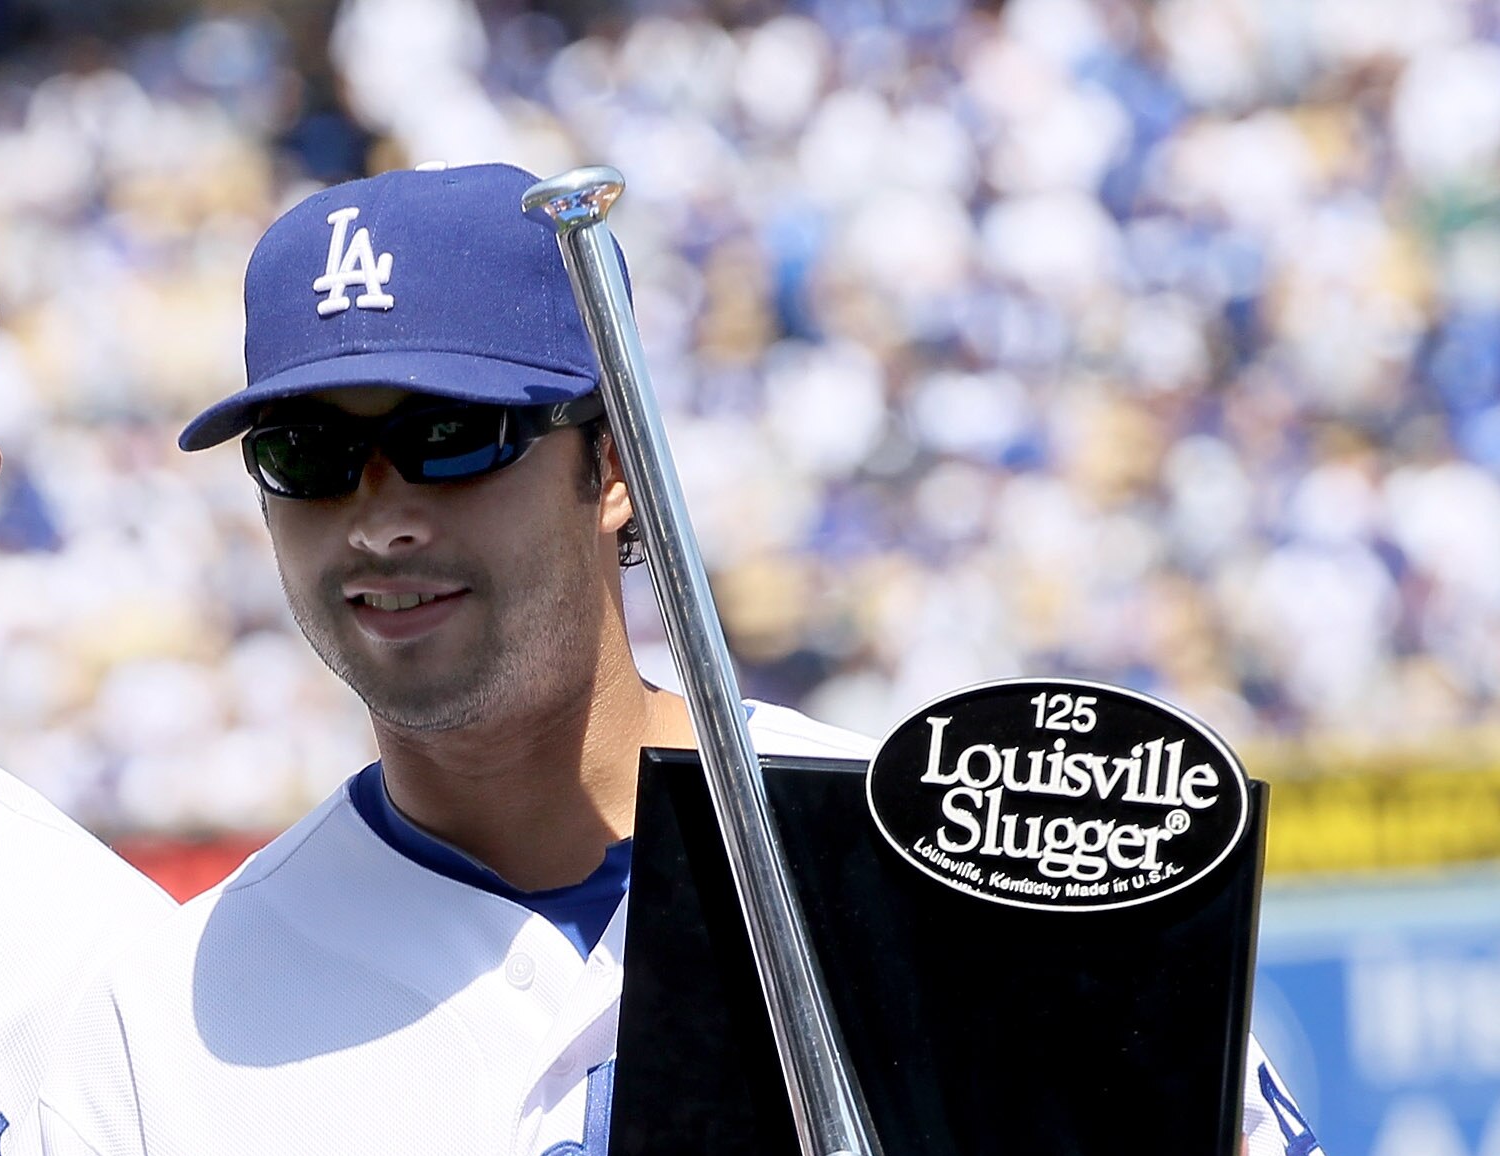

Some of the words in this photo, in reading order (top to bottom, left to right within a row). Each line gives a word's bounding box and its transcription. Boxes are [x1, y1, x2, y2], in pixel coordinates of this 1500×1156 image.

[313, 207, 394, 315] LA
[1031, 692, 1097, 733] 125
[920, 715, 1219, 809] Louisville
[989, 869, 1061, 899] Kentucky
[1065, 882, 1108, 897] Made
[1113, 878, 1129, 893] in
